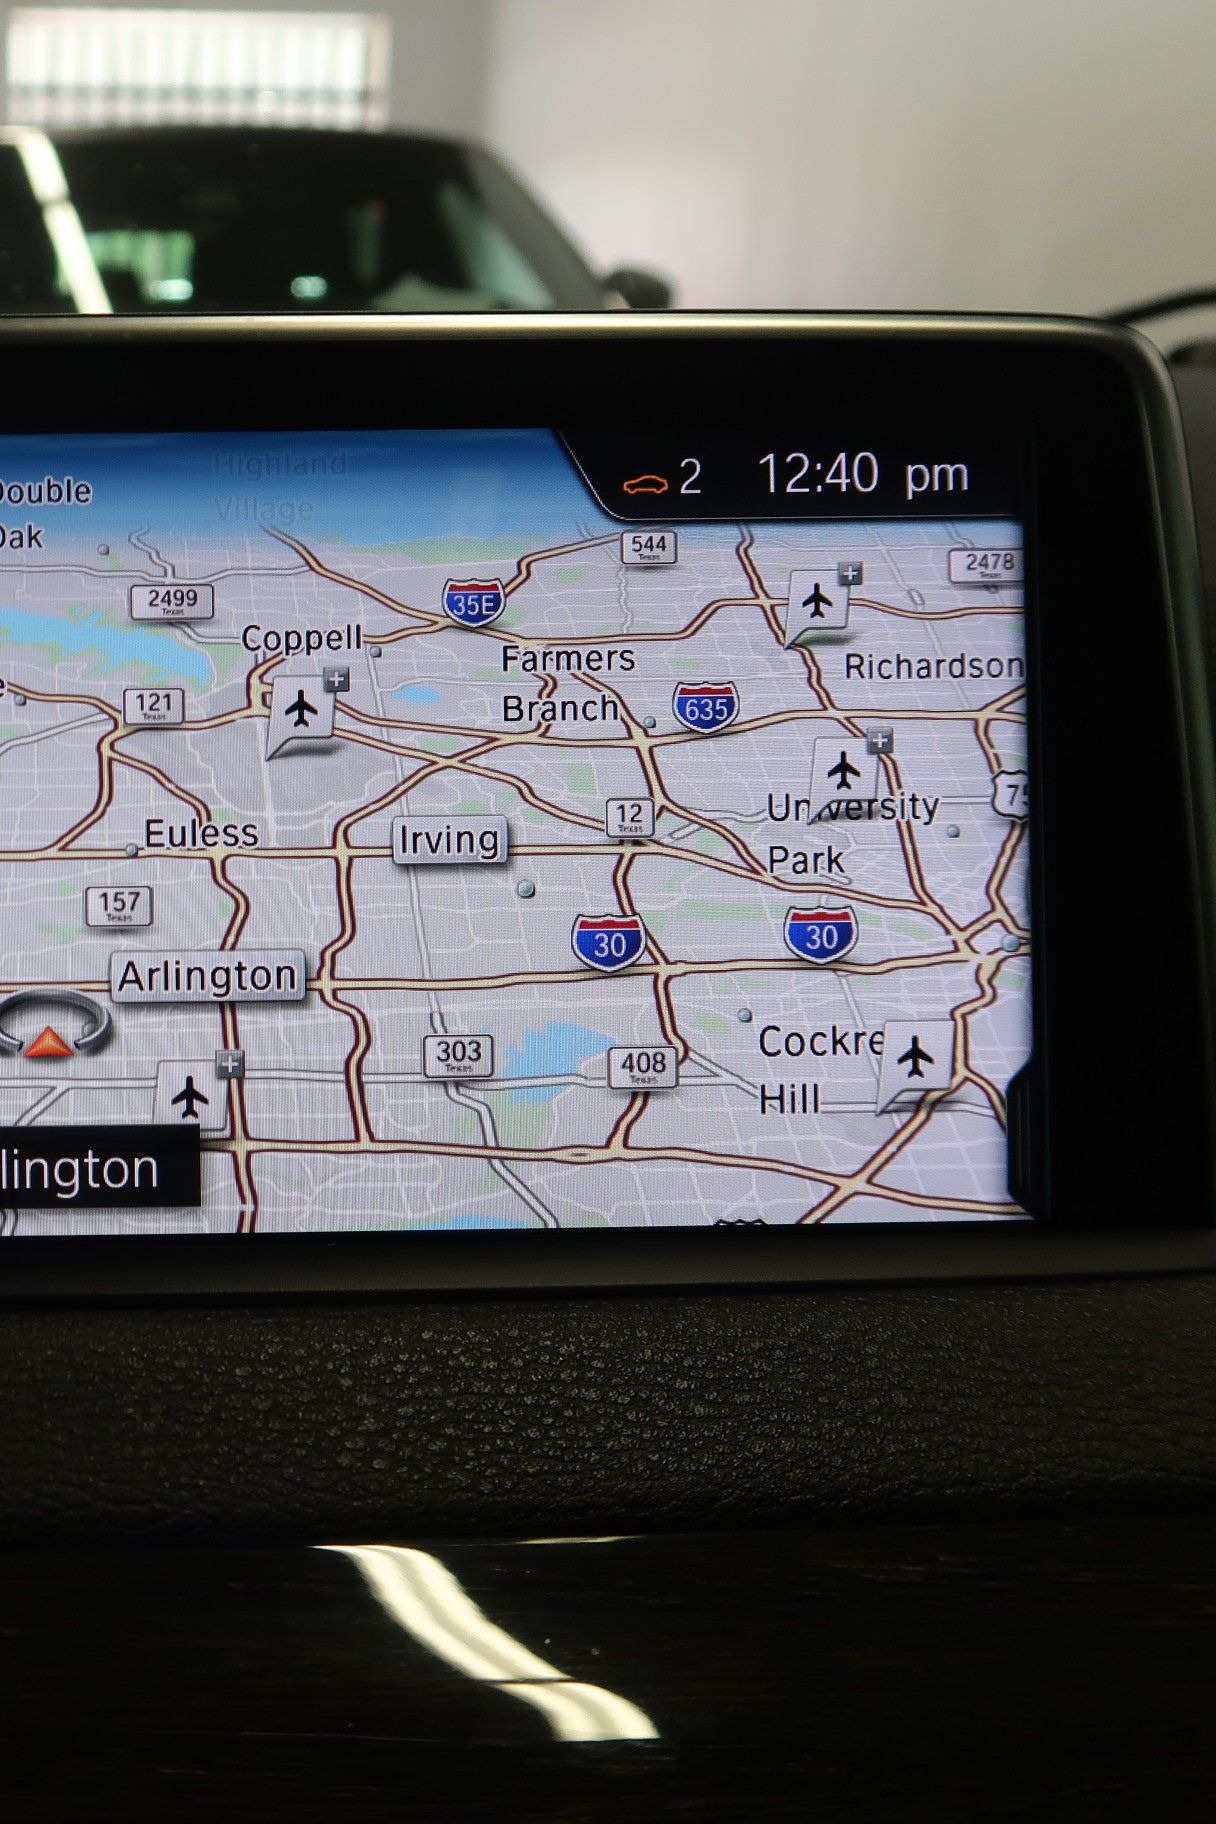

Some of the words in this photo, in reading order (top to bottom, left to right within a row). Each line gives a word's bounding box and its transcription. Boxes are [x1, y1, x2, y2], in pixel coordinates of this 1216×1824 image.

[679, 459, 702, 493] 2
[759, 452, 879, 493] 12:40
[906, 464, 969, 499] pm
[632, 536, 666, 553] 544
[966, 553, 1015, 571] 2478
[147, 589, 198, 608] 2499
[453, 594, 494, 616] 35E
[242, 625, 363, 655] Coppell
[502, 646, 635, 672] Farmers
[845, 653, 1025, 680] Richardson
[135, 694, 172, 712] 121
[503, 696, 619, 722] Branch
[685, 699, 728, 721] 635
[618, 804, 643, 824] 12
[768, 794, 940, 825] Unversity
[145, 819, 259, 848] Euless
[401, 825, 499, 860] Irving
[769, 846, 845, 875] Park
[98, 892, 141, 912] 157
[593, 933, 627, 958] 30
[806, 926, 839, 950] 30
[118, 958, 297, 997] Arlington
[435, 1042, 482, 1062] 303
[621, 1052, 666, 1073] 408
[759, 1084, 822, 1115] Hill
